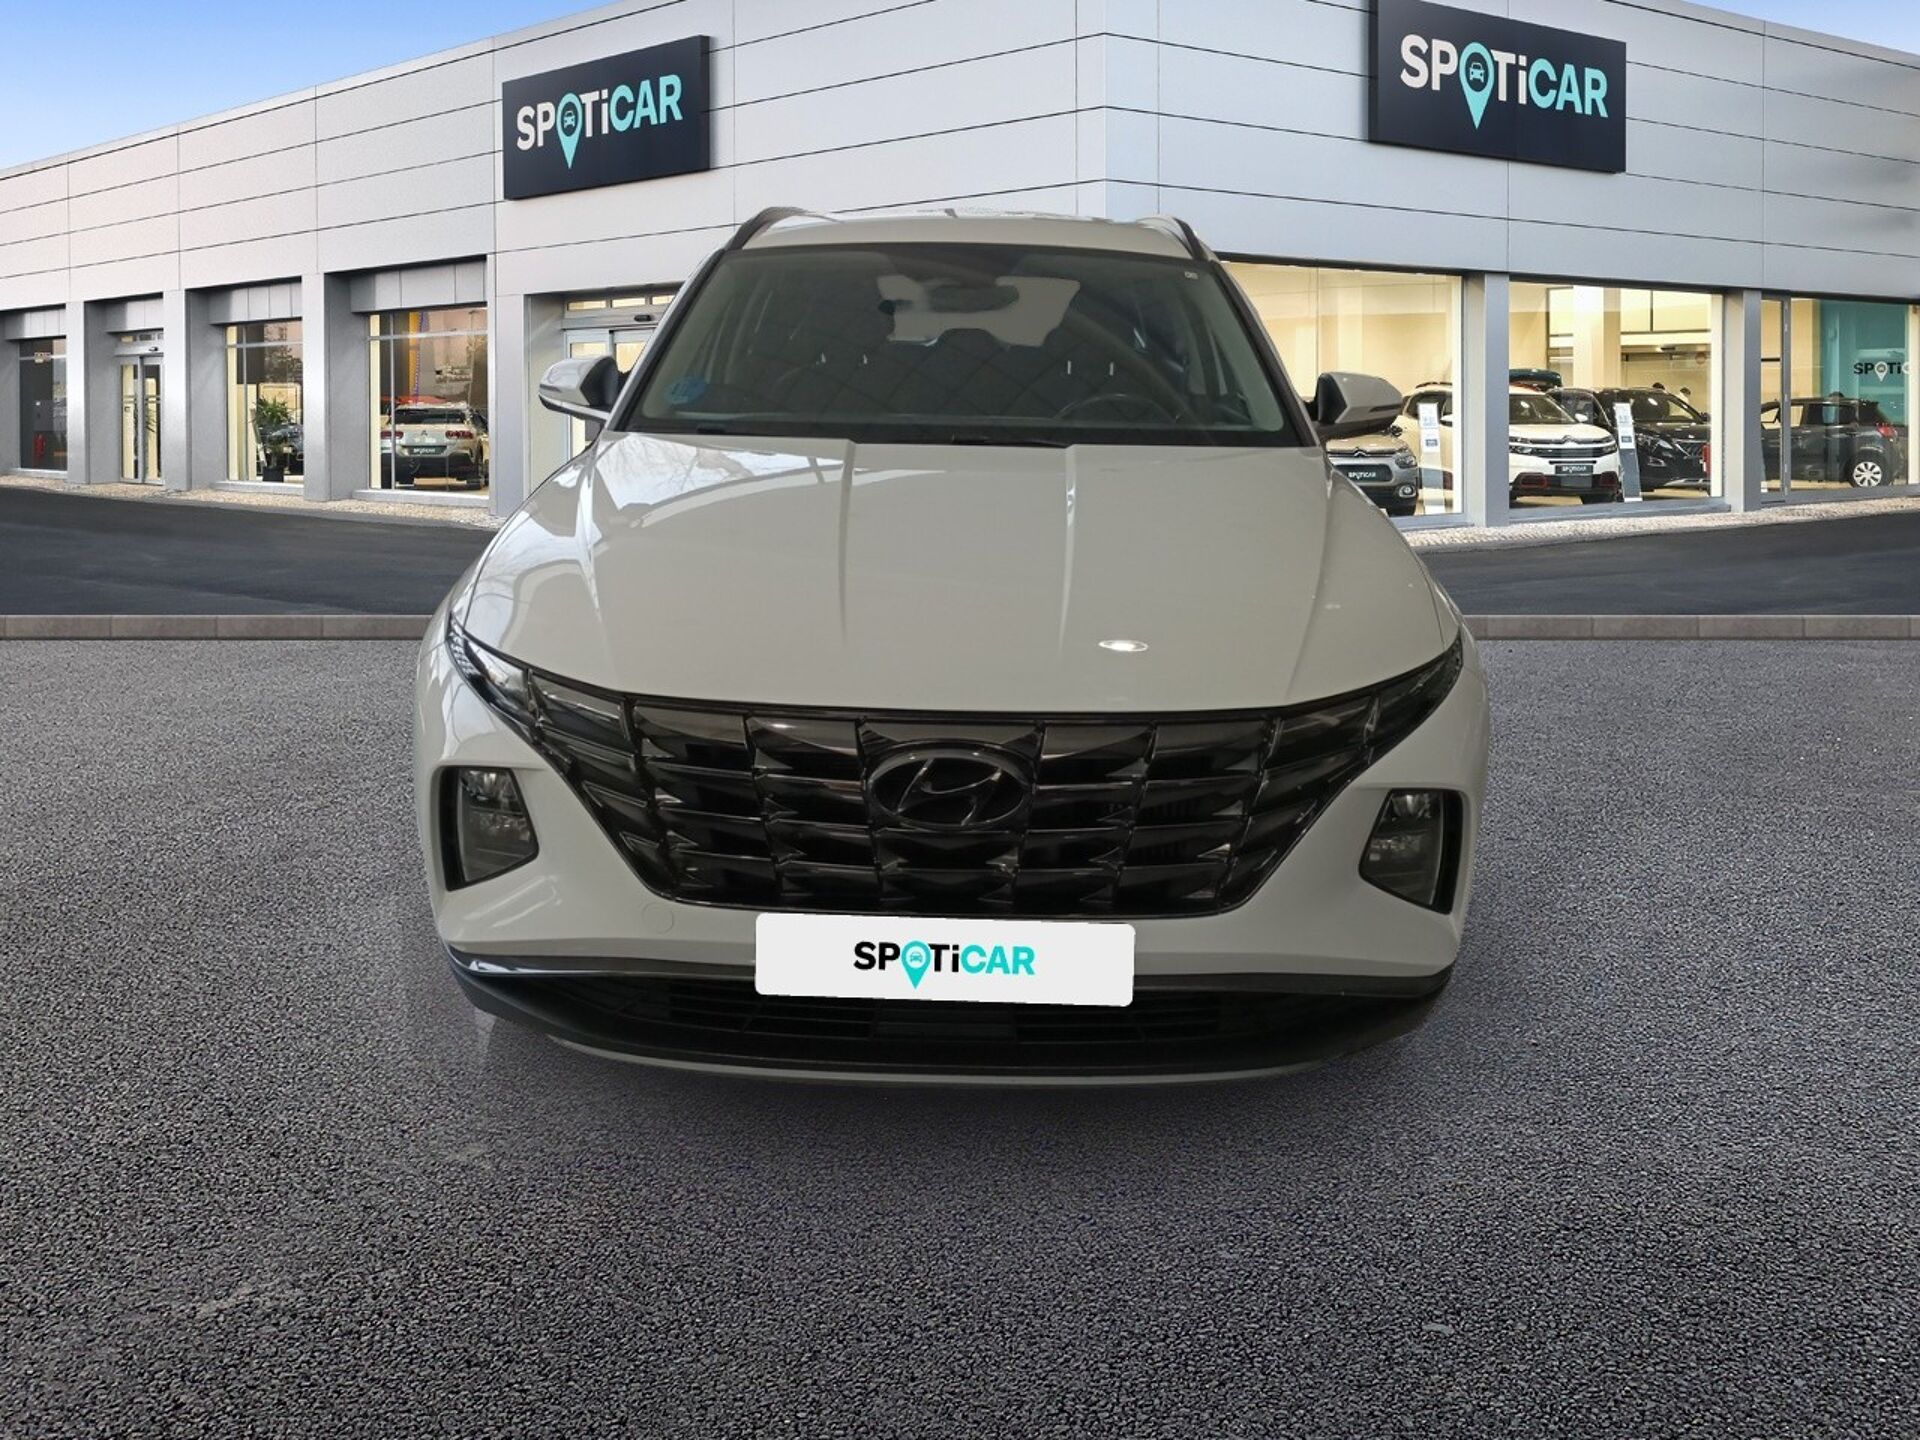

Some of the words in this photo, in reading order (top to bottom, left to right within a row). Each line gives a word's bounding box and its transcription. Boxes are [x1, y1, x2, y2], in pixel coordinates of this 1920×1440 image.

[516, 74, 683, 169] SPOTiCAR
[1400, 34, 1608, 130] SPOTiCAR
[853, 940, 1036, 990] SPOTiCAR
